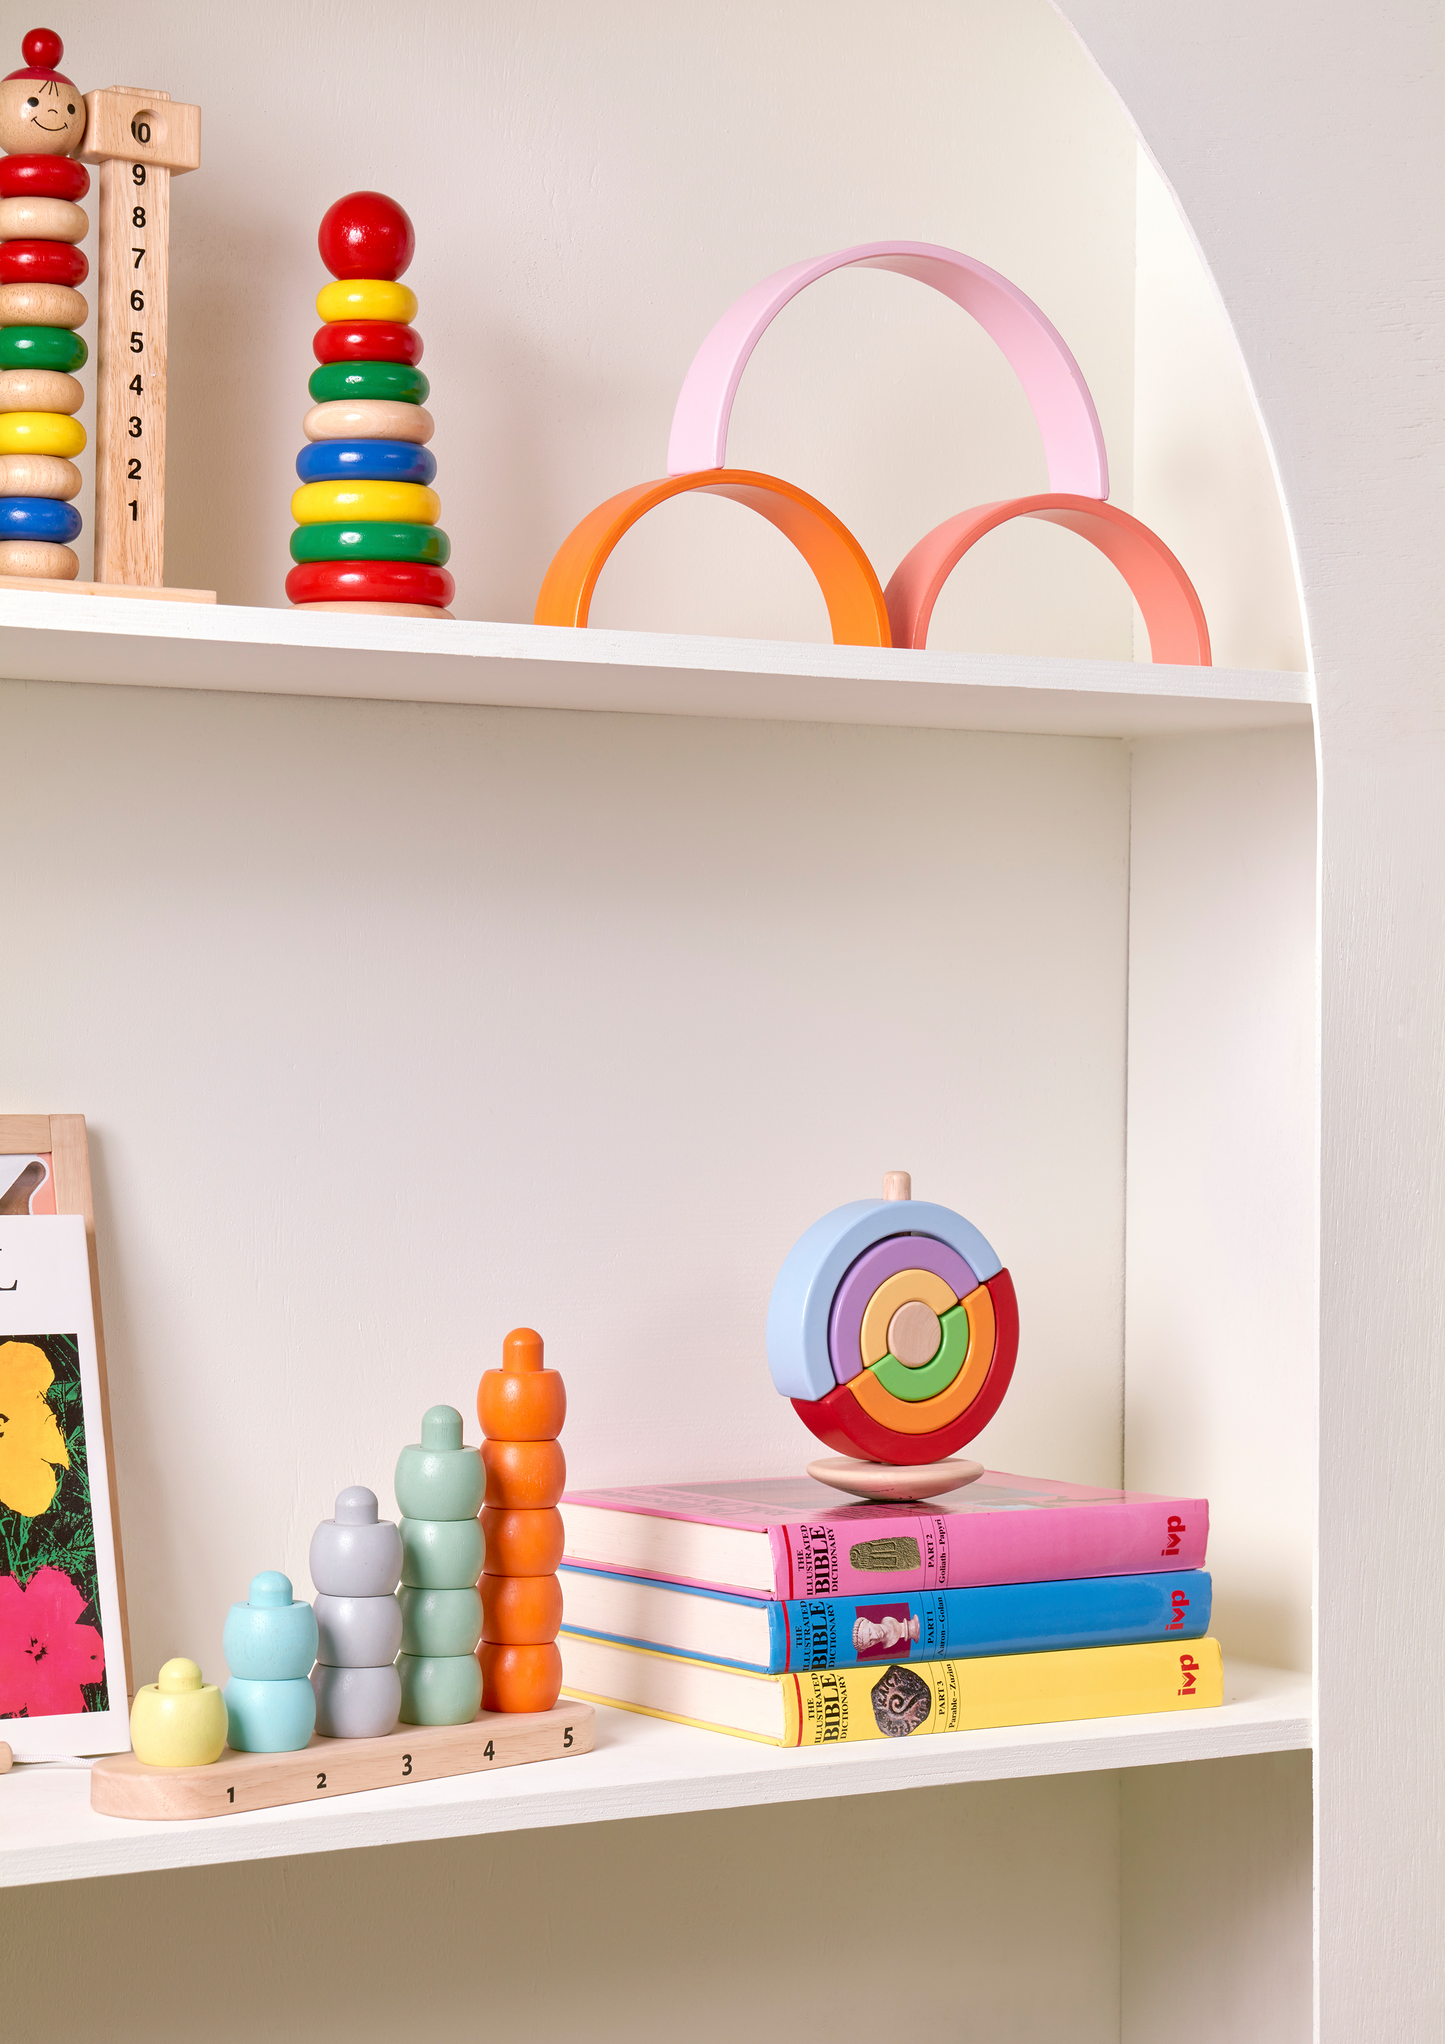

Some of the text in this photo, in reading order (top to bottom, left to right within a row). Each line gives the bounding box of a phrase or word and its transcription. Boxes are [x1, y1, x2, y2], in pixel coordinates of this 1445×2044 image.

[132, 164, 146, 186] 9
[132, 207, 146, 228] 8
[131, 247, 146, 269] 7
[130, 290, 145, 311] 6
[130, 332, 144, 354] 5
[129, 374, 143, 396] 4
[128, 416, 142, 438] 3
[128, 458, 142, 480] 2
[128, 500, 138, 522] 1
[935, 1519, 946, 1545] Papyri
[1161, 1515, 1186, 1556] ivp
[797, 1549, 805, 1571] THE
[800, 1525, 813, 1595] ILLUSTRATED
[809, 1525, 830, 1595] BIBLE
[826, 1527, 838, 1592] DICTIONARY
[927, 1541, 935, 1568] PART
[938, 1553, 947, 1584] Goliath
[937, 1597, 946, 1622] Golan
[1165, 1589, 1190, 1631] ivp
[795, 1626, 803, 1648] THE
[800, 1600, 811, 1671] ILLUSTRATED
[809, 1601, 828, 1670] BIBLE
[826, 1603, 837, 1668] DICTIONARY
[927, 1616, 935, 1644] PART
[937, 1630, 946, 1656] Aaron
[946, 1663, 957, 1690] Zuzim
[1177, 1654, 1200, 1697] ivp
[807, 1698, 815, 1721] THE
[811, 1672, 824, 1743] ILLUSTRATED
[820, 1673, 841, 1742] BIBLE
[836, 1675, 849, 1739] DICTIONARY
[938, 1687, 946, 1715] PART
[948, 1698, 958, 1728] Parable
[226, 1726, 574, 1803] 1 2 3 4 5
